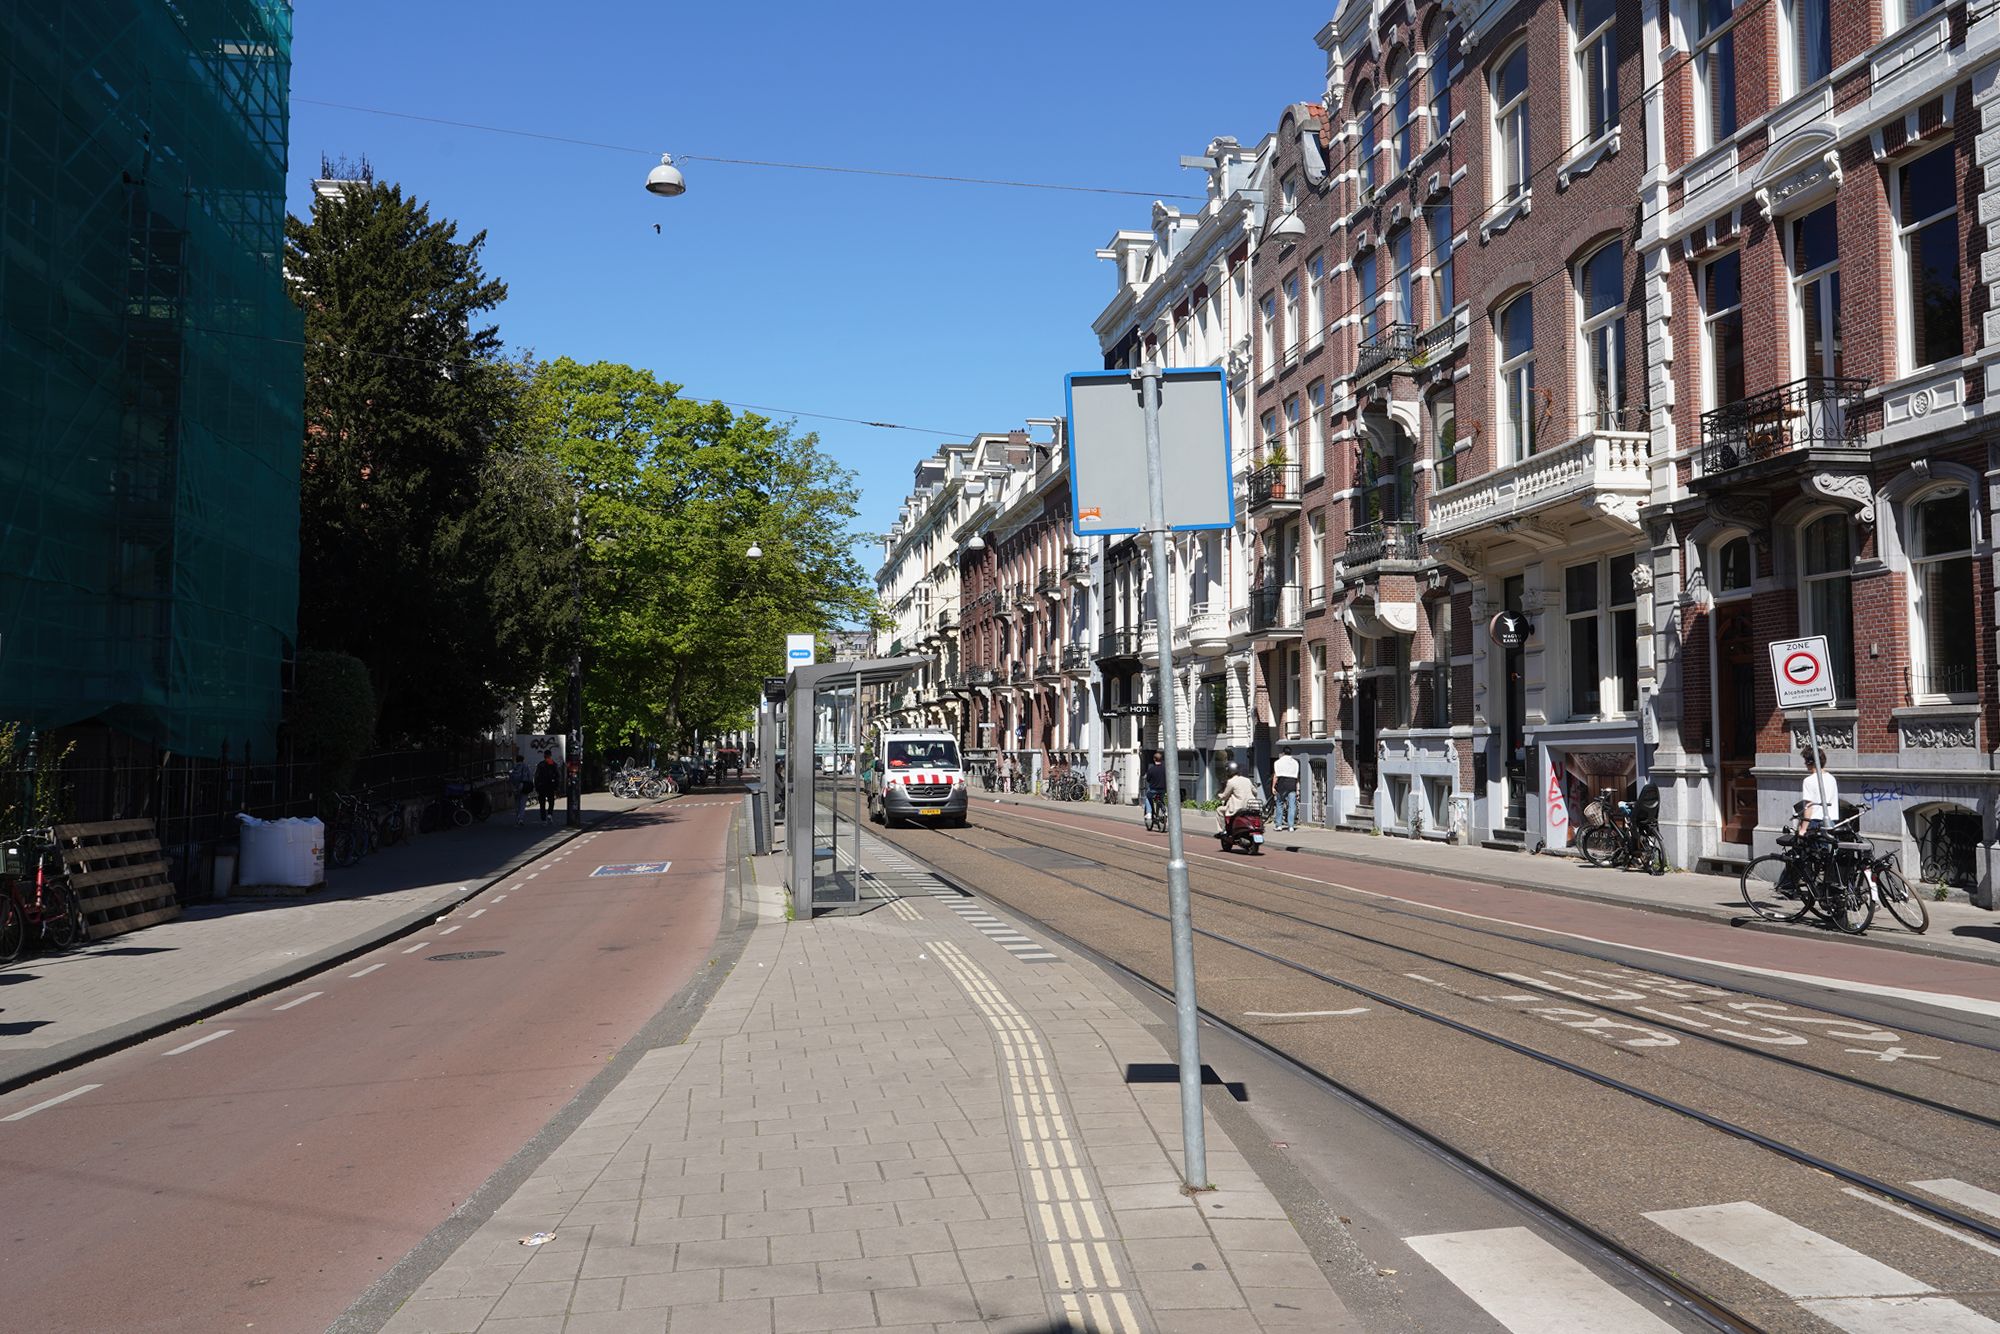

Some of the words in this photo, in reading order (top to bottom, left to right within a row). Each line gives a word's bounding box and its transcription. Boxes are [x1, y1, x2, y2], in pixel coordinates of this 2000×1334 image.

[1786, 642, 1810, 651] ZONE
[1784, 686, 1827, 696] Alcoholverbod
[1523, 1002, 1900, 1047] BUS
